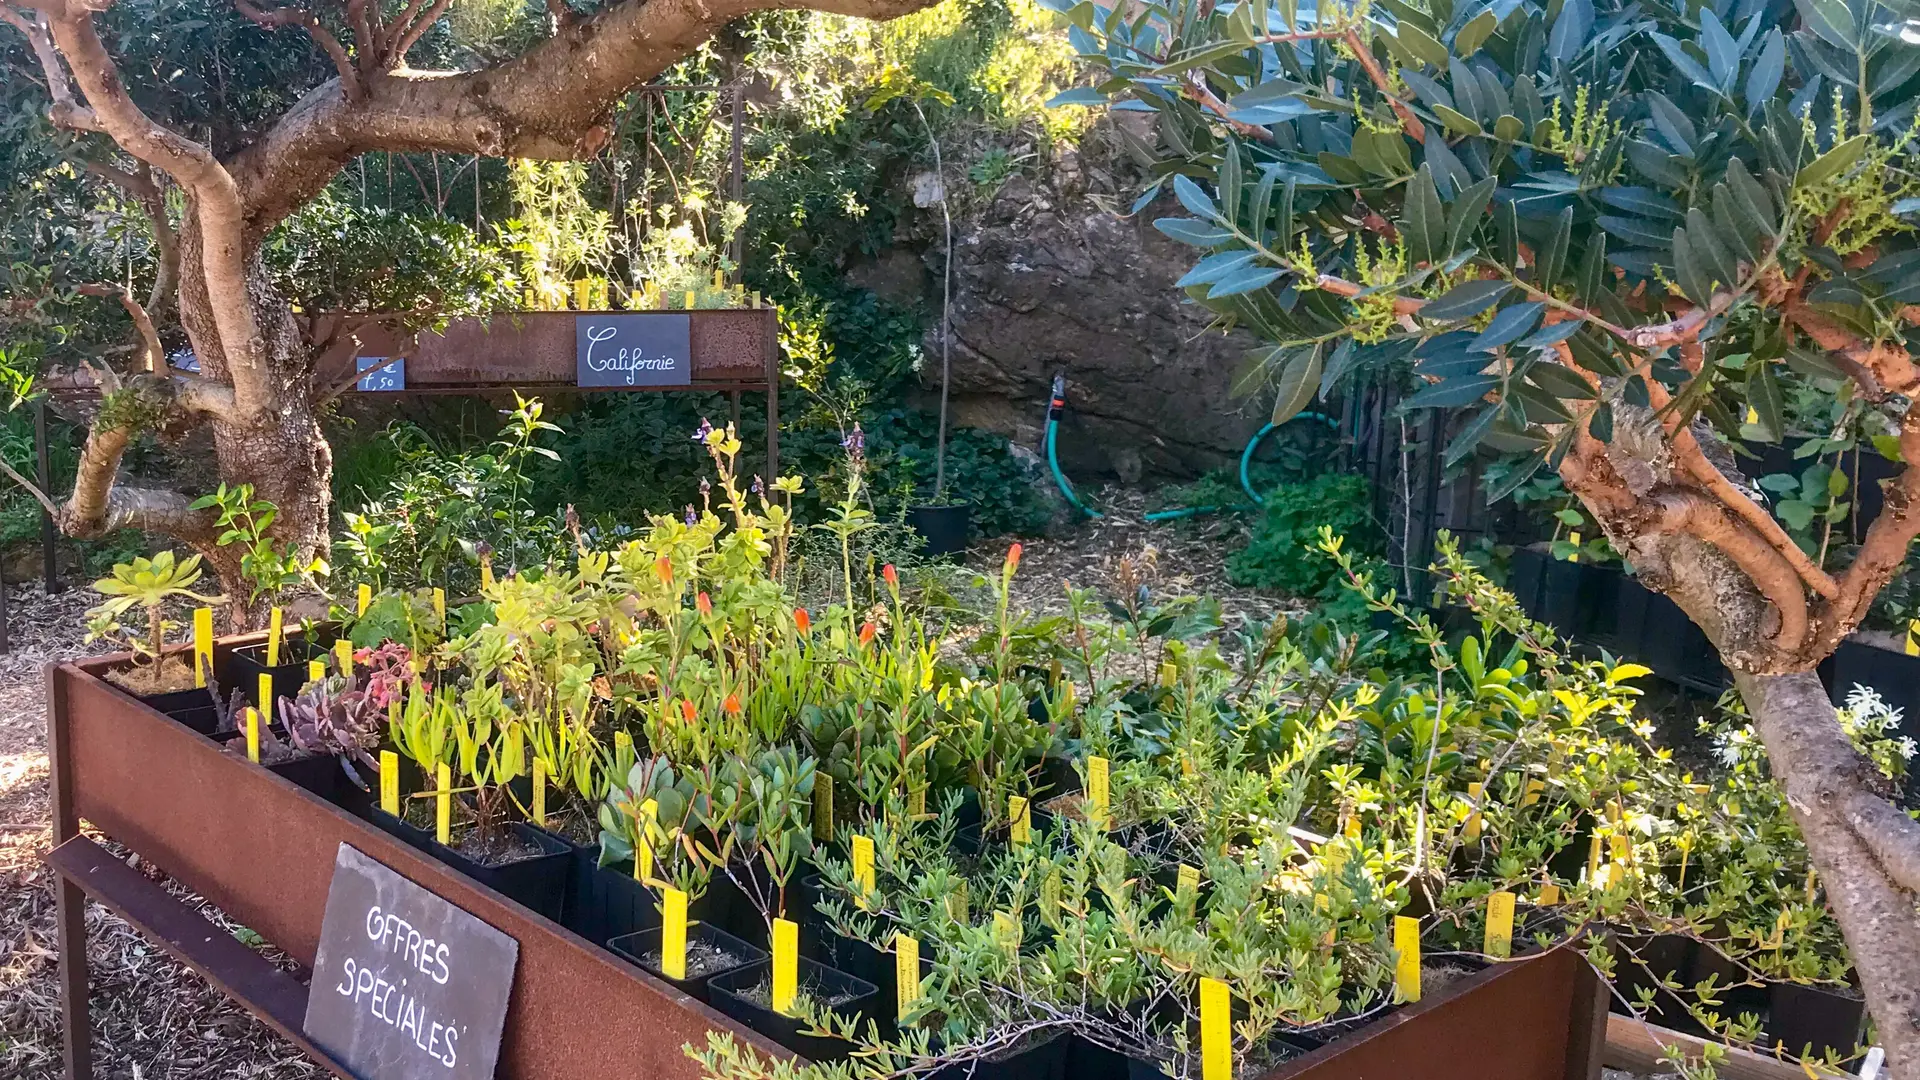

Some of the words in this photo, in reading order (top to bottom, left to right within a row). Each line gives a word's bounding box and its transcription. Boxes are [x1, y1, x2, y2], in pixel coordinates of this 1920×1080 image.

[587, 326, 675, 385] Californie
[366, 905, 450, 985] OFFRES
[336, 958, 458, 1068] SPÉCIALES
